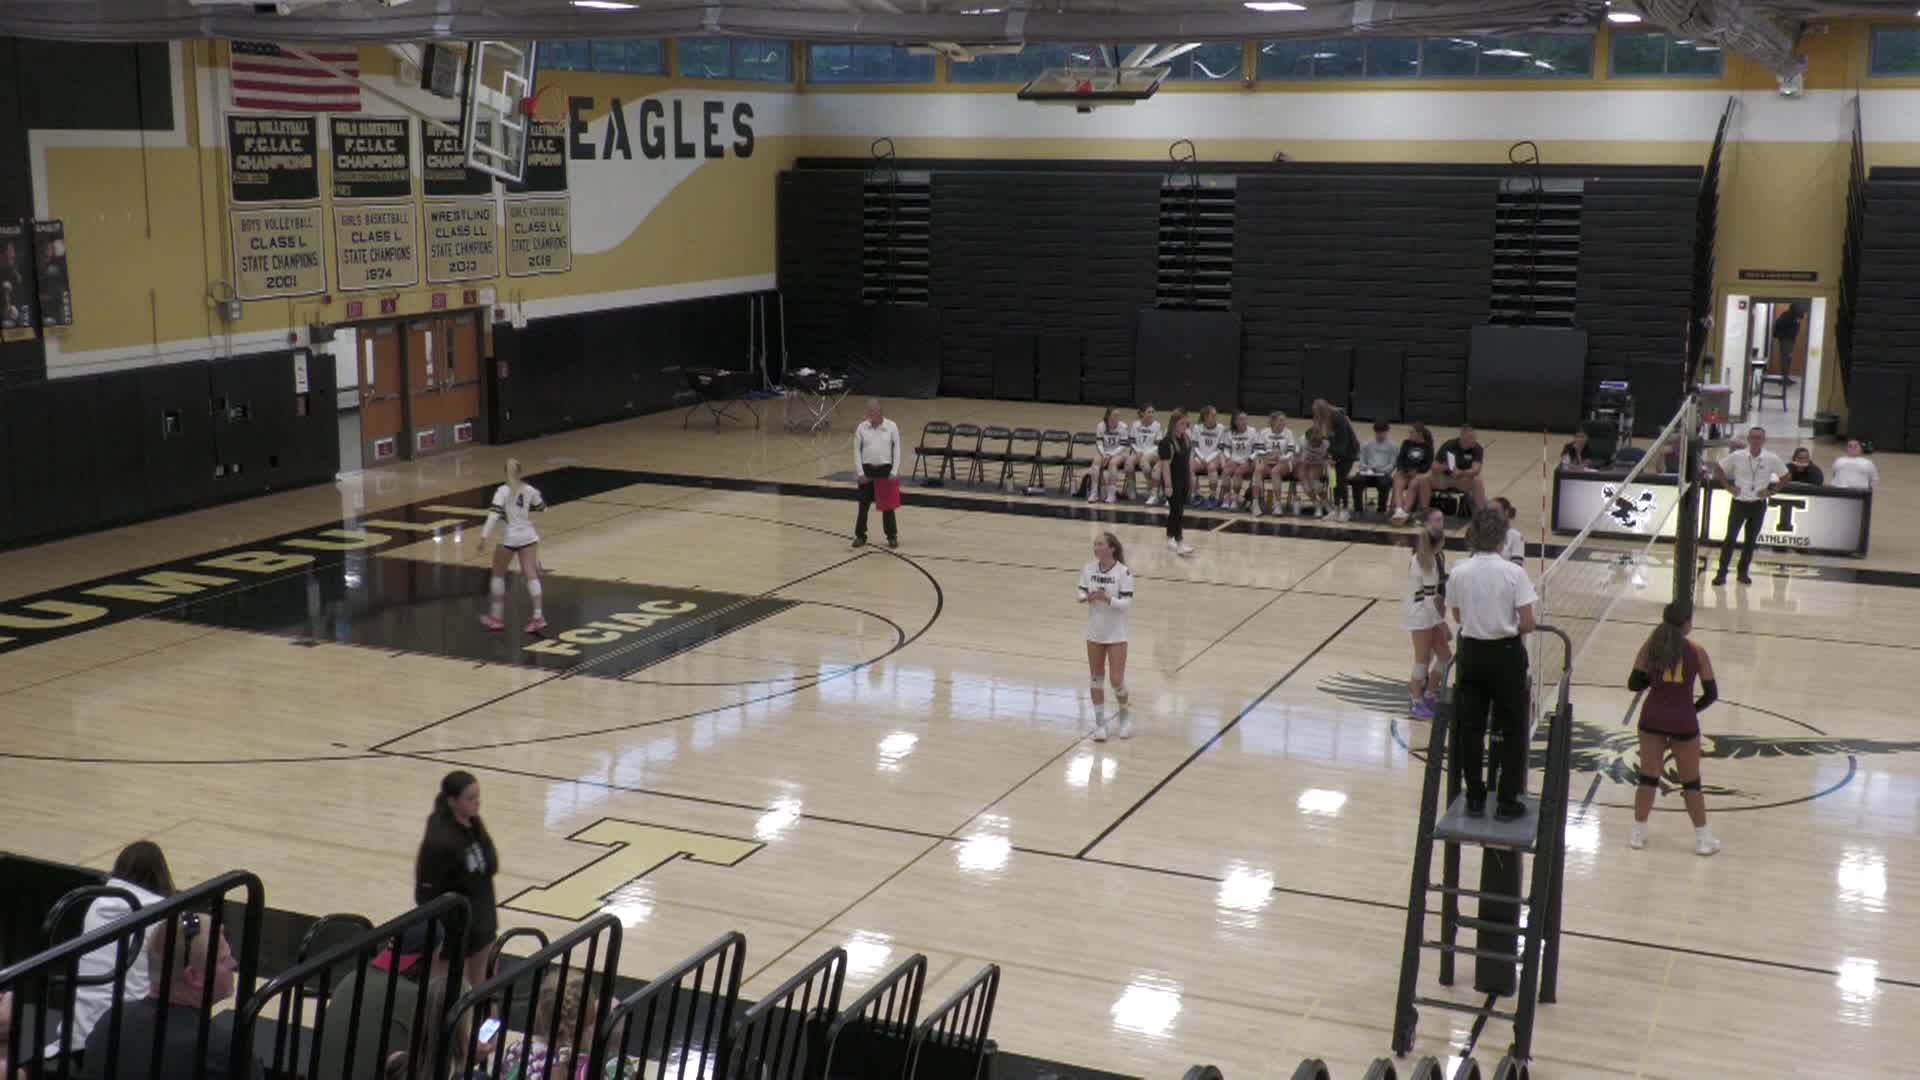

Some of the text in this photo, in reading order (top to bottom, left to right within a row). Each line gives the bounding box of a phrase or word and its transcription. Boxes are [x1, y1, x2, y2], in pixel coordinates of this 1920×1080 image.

[568, 96, 755, 160] EAGLES
[236, 155, 312, 170] CHAMPIONS
[337, 155, 405, 169] CHAMPIONS
[432, 209, 490, 222] WRESTLING
[264, 216, 312, 230] VOLLEYBALL
[514, 222, 546, 235] CLASS
[351, 231, 403, 243] CLASS L
[435, 225, 487, 239] CLASS LL
[250, 236, 308, 250] CLASS L
[432, 240, 493, 258] STATE CHAMPIONS
[511, 239, 531, 252] STATE
[242, 251, 319, 272] STATE CHAMPIONS
[344, 246, 411, 264] STATE CHAMPIONS
[266, 275, 297, 289] 2001
[516, 493, 524, 508] 4
[1757, 536, 1810, 546] ATHLETICS
[521, 600, 698, 656] FCIAC
